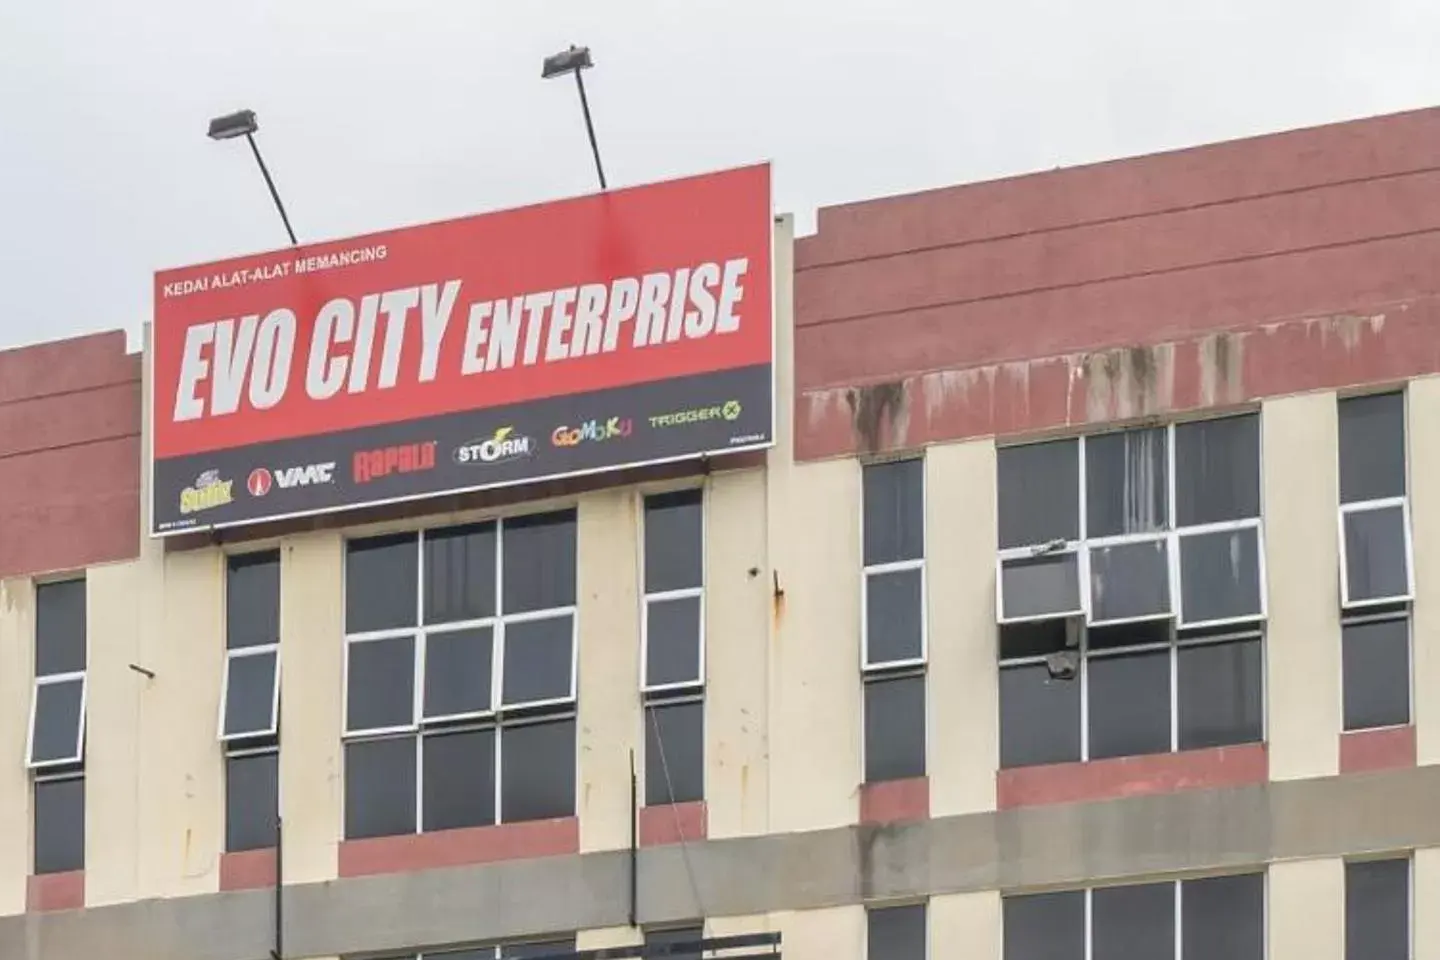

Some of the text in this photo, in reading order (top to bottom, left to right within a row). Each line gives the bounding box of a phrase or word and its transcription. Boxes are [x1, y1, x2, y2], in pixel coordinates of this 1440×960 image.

[163, 245, 388, 298] KEDAI ALAT-ALAT MEMANCING
[173, 257, 749, 423] EVO CITY ENTERPRISE
[648, 407, 721, 429] TRIGGER
[458, 434, 530, 462] STORM
[274, 461, 336, 489] VMC
